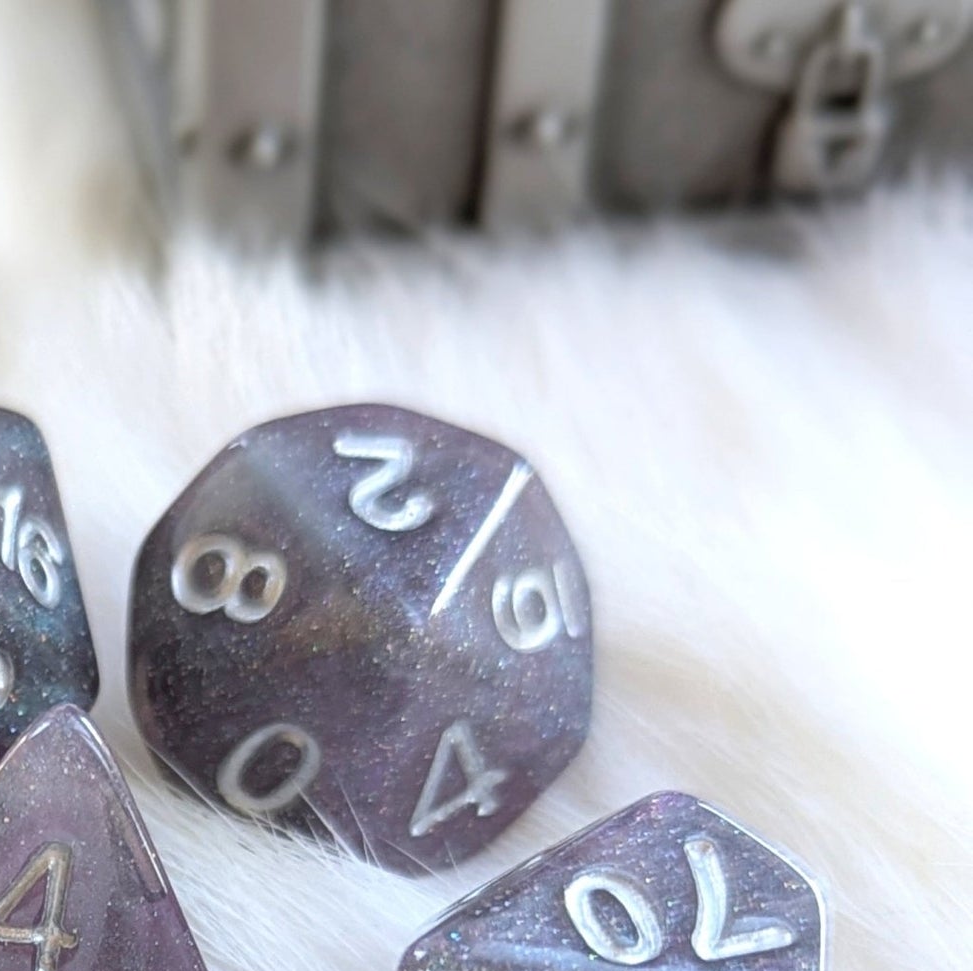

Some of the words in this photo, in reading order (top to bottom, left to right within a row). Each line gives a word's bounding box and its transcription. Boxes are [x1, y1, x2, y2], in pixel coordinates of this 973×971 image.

[332, 432, 434, 531] 2
[171, 531, 288, 624] 8
[409, 719, 509, 838] 4
[564, 837, 798, 966] 70
